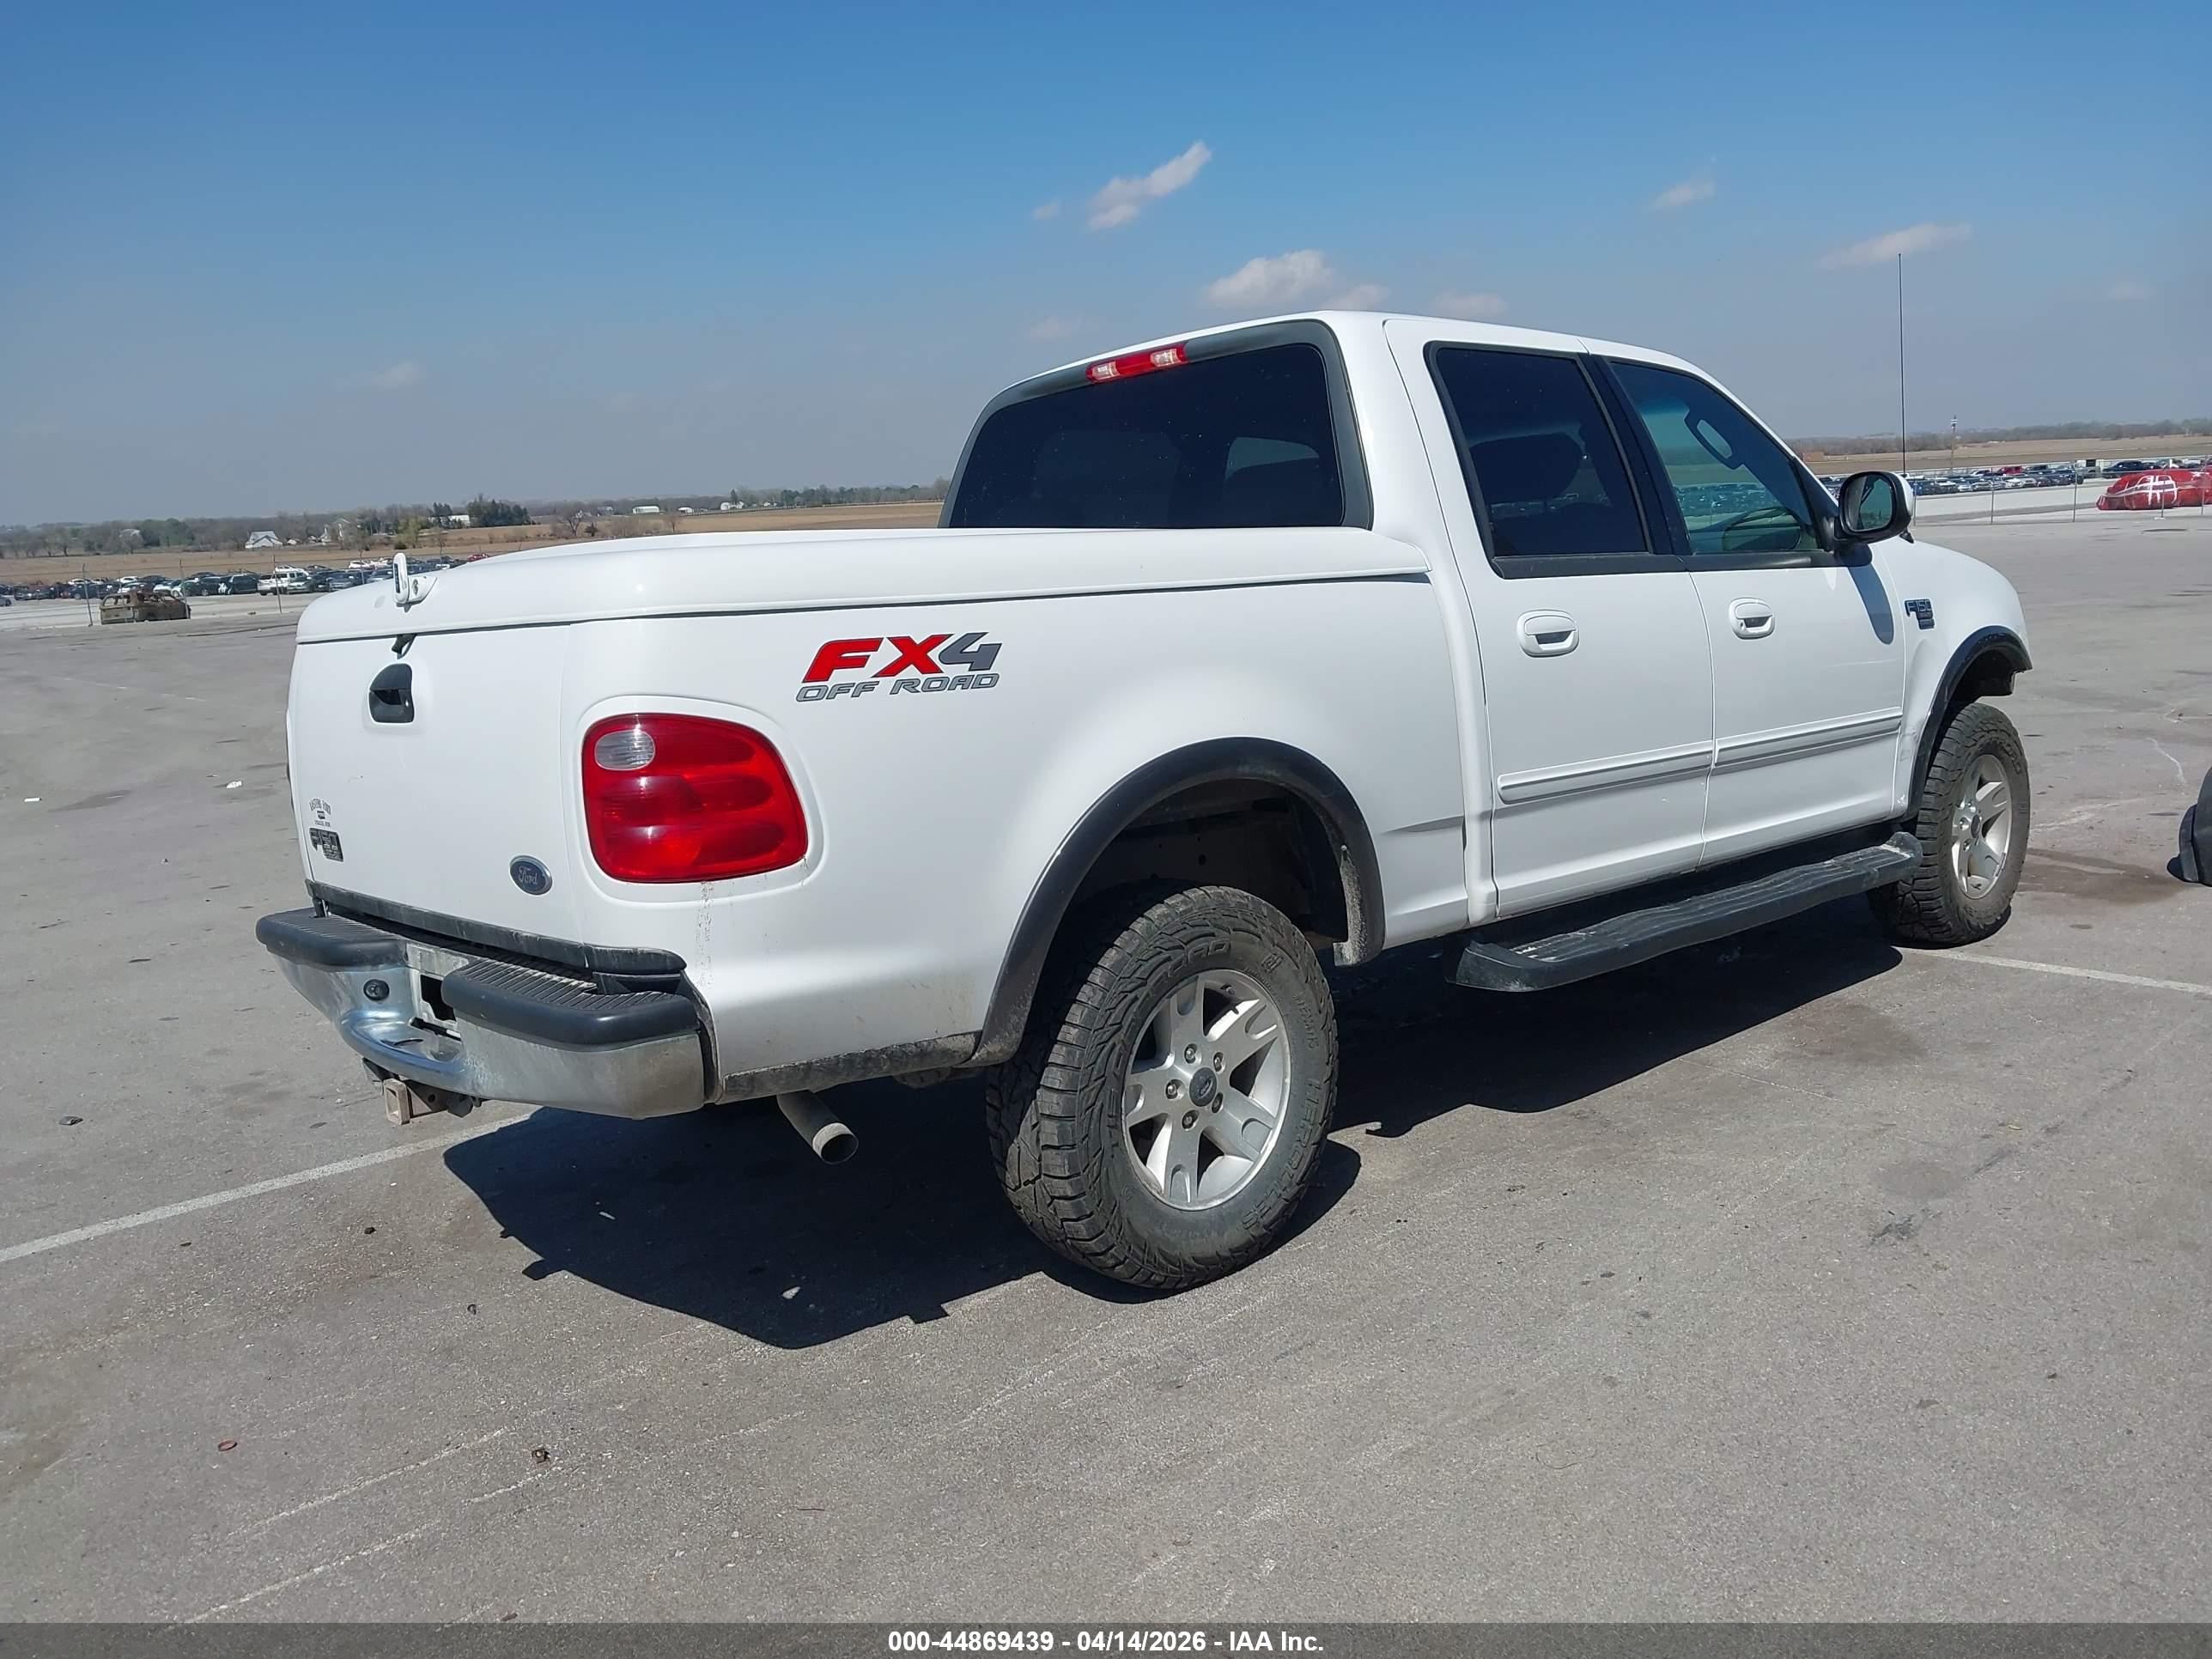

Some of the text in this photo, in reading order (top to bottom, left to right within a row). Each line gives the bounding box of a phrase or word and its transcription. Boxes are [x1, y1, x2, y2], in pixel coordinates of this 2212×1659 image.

[802, 632, 1003, 684] FX4
[795, 673, 1000, 702] OFF ROAD
[518, 866, 538, 885] Ford
